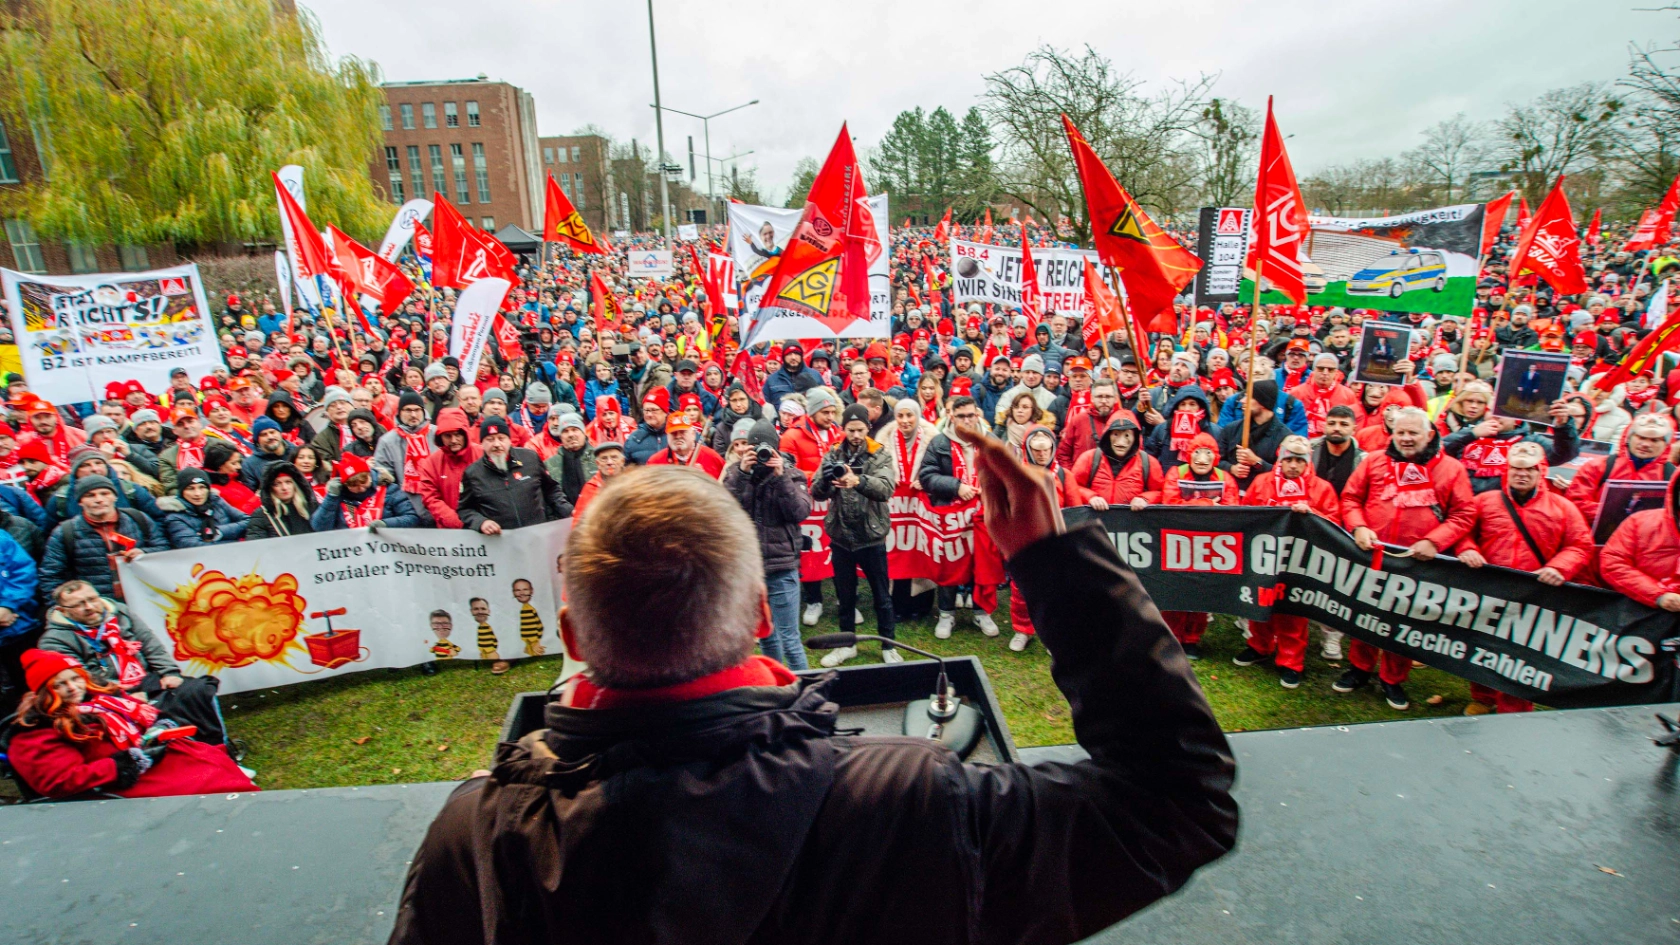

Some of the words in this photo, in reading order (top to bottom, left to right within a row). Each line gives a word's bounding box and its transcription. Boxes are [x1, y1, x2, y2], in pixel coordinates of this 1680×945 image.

[956, 244, 989, 260] B8.4
[996, 256, 1042, 284] JETT
[1046, 259, 1098, 288] REICH
[957, 279, 987, 296] WIR
[58, 296, 163, 327] RICHT'S!
[1040, 292, 1084, 311] TREI
[41, 356, 68, 371] B2
[71, 355, 93, 368] IST
[97, 346, 202, 365] KAMPFBEREIT!
[316, 546, 364, 561] Eure
[366, 540, 448, 557] Vorhaben
[451, 544, 488, 557] sind
[314, 565, 390, 584] sozialer
[394, 561, 496, 580] Sprengstoff!
[1165, 533, 1237, 571] DES
[1251, 534, 1656, 684] GELDVERBRENNENS
[1239, 586, 1254, 604] &
[1288, 587, 1353, 622] sollen
[1355, 613, 1392, 637] die
[1470, 646, 1554, 692] zahlen
